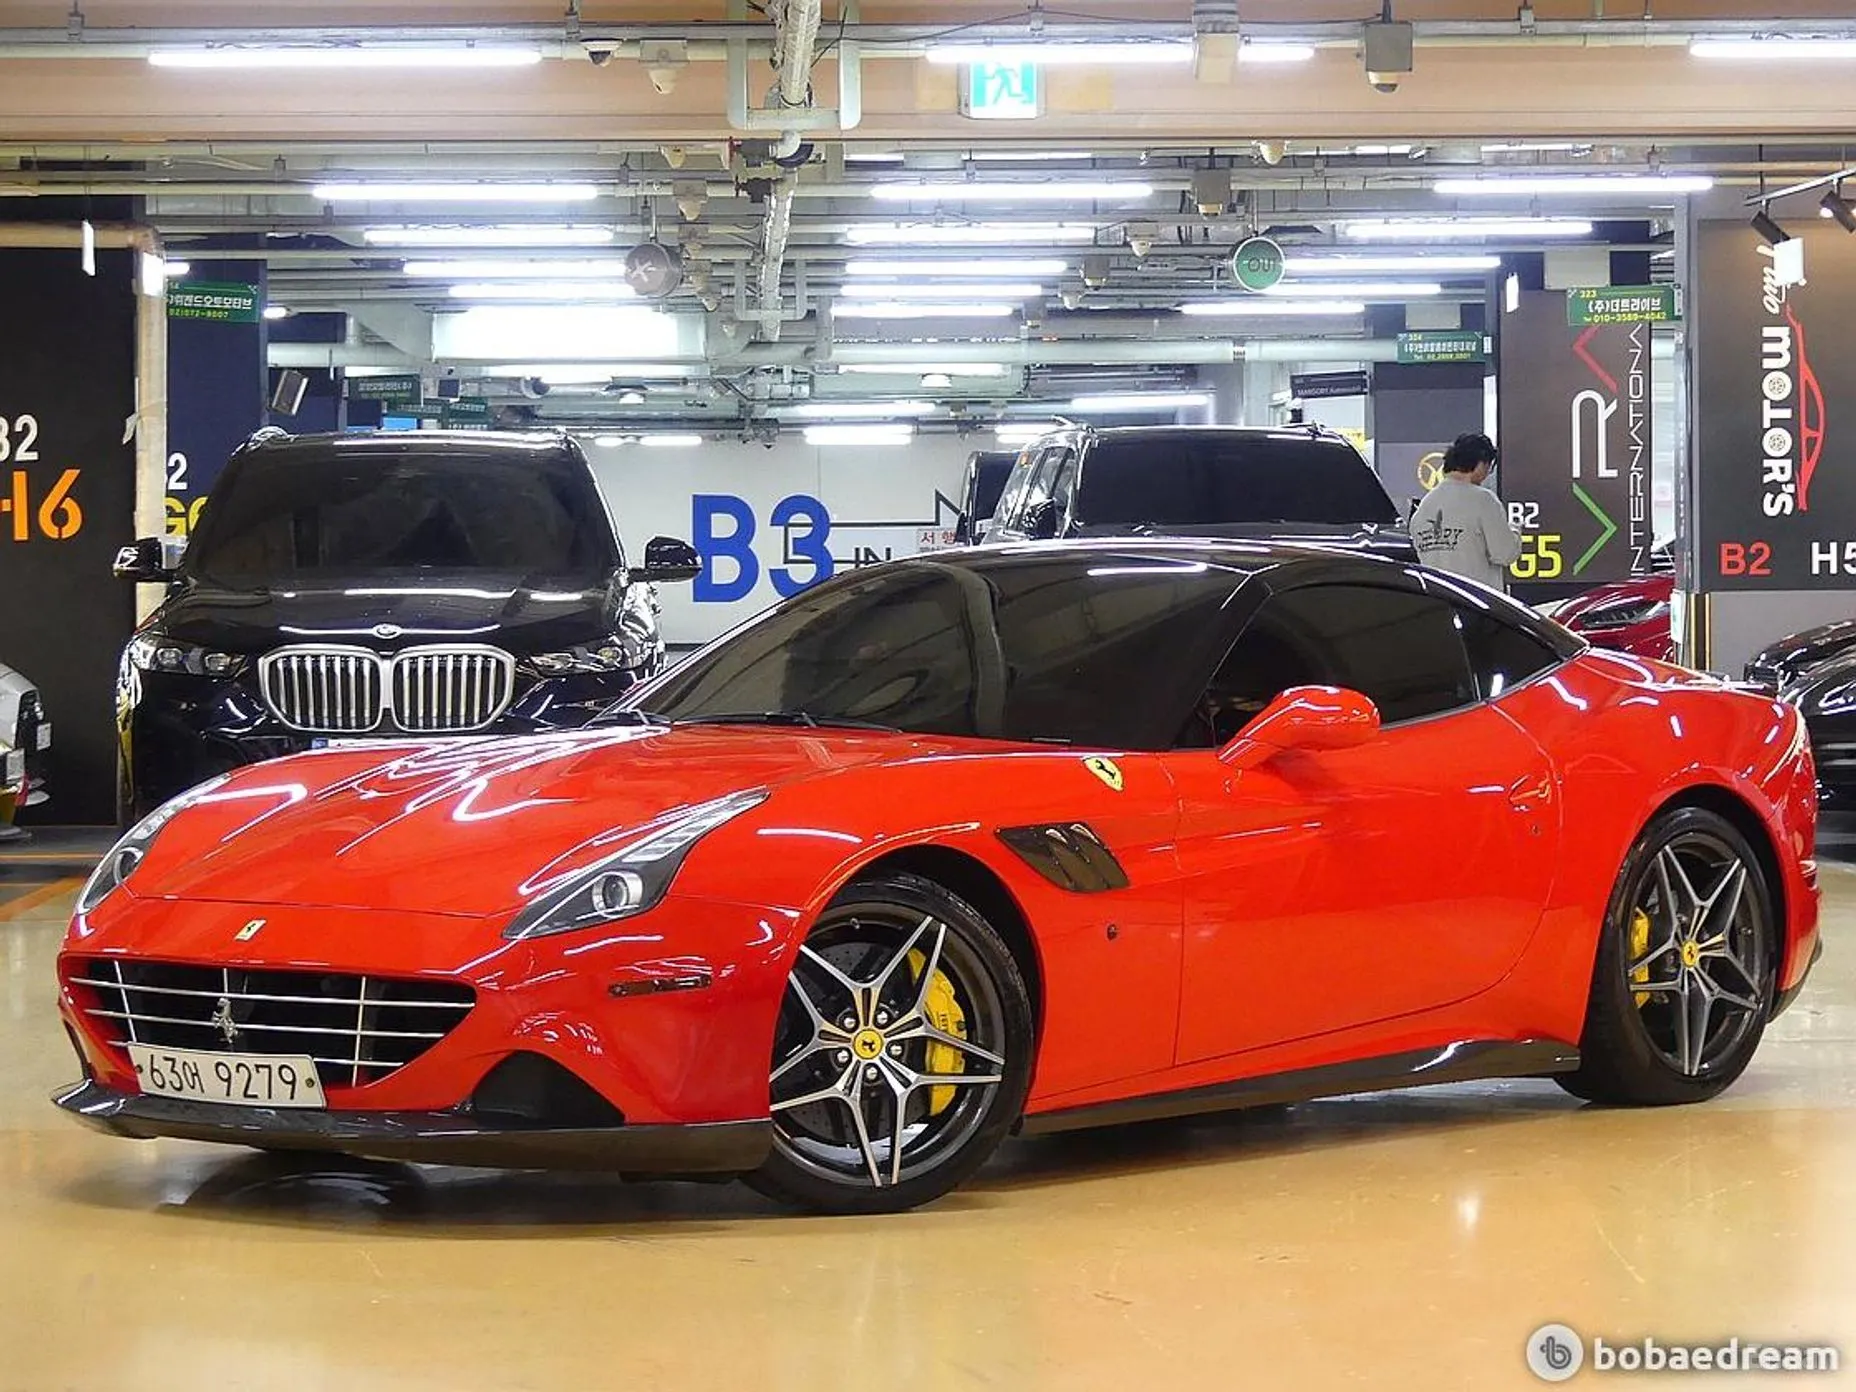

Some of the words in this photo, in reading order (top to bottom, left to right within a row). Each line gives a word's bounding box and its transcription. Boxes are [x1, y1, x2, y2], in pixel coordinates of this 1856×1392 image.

[1580, 290, 1597, 298] 323
[1508, 502, 1540, 528] B2
[692, 494, 835, 603] B3
[1510, 535, 1562, 578] G5
[1721, 541, 1772, 575] B2
[150, 1054, 205, 1093] 63어
[214, 1061, 297, 1100] 9279
